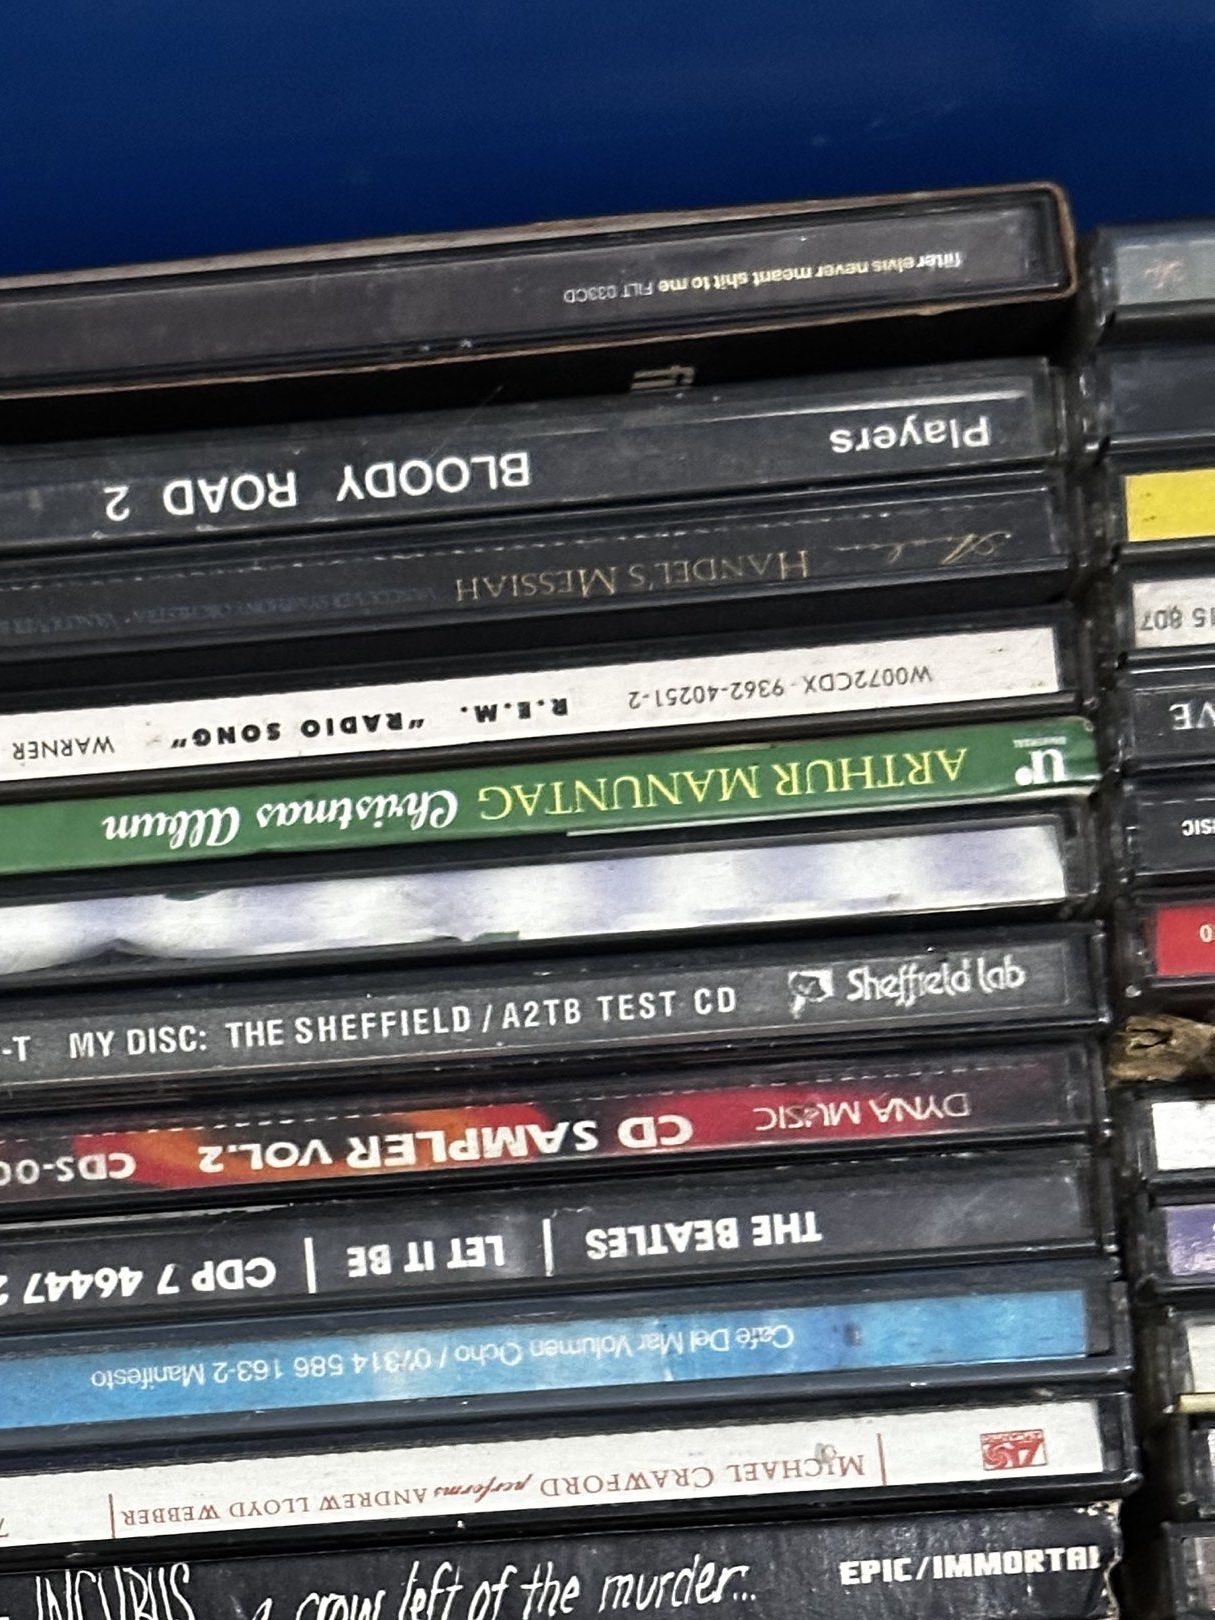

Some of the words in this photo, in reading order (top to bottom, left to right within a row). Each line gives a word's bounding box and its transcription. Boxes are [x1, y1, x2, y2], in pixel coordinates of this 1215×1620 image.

[829, 413, 991, 454] Players
[162, 470, 297, 516] ROAD
[336, 451, 531, 502] BLOODY
[103, 484, 130, 522] 2
[628, 679, 785, 710] 9362-40251-2
[803, 666, 933, 694] W0072CDX
[460, 698, 568, 724] R.E.M.
[12, 736, 115, 761] WARNER
[771, 748, 968, 796] ARTHUR
[256, 789, 458, 831] Christmas
[477, 765, 761, 821] MANUNTAG
[101, 806, 241, 850] Album
[69, 1030, 115, 1059] MY
[126, 1024, 207, 1056] DISC:
[224, 1019, 285, 1049] THE
[596, 990, 676, 1022] TEST
[694, 986, 737, 1016] CD
[868, 1092, 971, 1123] DYNA
[339, 1120, 599, 1163] SAMPLER
[617, 1114, 694, 1149] CD
[198, 1139, 338, 1175] VOL.2
[585, 1217, 740, 1260] BEATLES
[751, 1211, 823, 1247] THE
[346, 1243, 392, 1278] BE
[403, 1240, 436, 1273] IT
[446, 1234, 512, 1269] LET
[22, 1266, 144, 1305] 46447
[156, 1263, 180, 1296] 7
[191, 1256, 277, 1292] CDP
[539, 1466, 715, 1497] CRAWFORD
[725, 1454, 865, 1483] MICHAEL
[319, 1487, 428, 1511] ANDREW
[433, 1473, 534, 1504] performs
[120, 1504, 221, 1526] WEBBER
[228, 1496, 310, 1518] LLOYD
[520, 1561, 580, 1620] the
